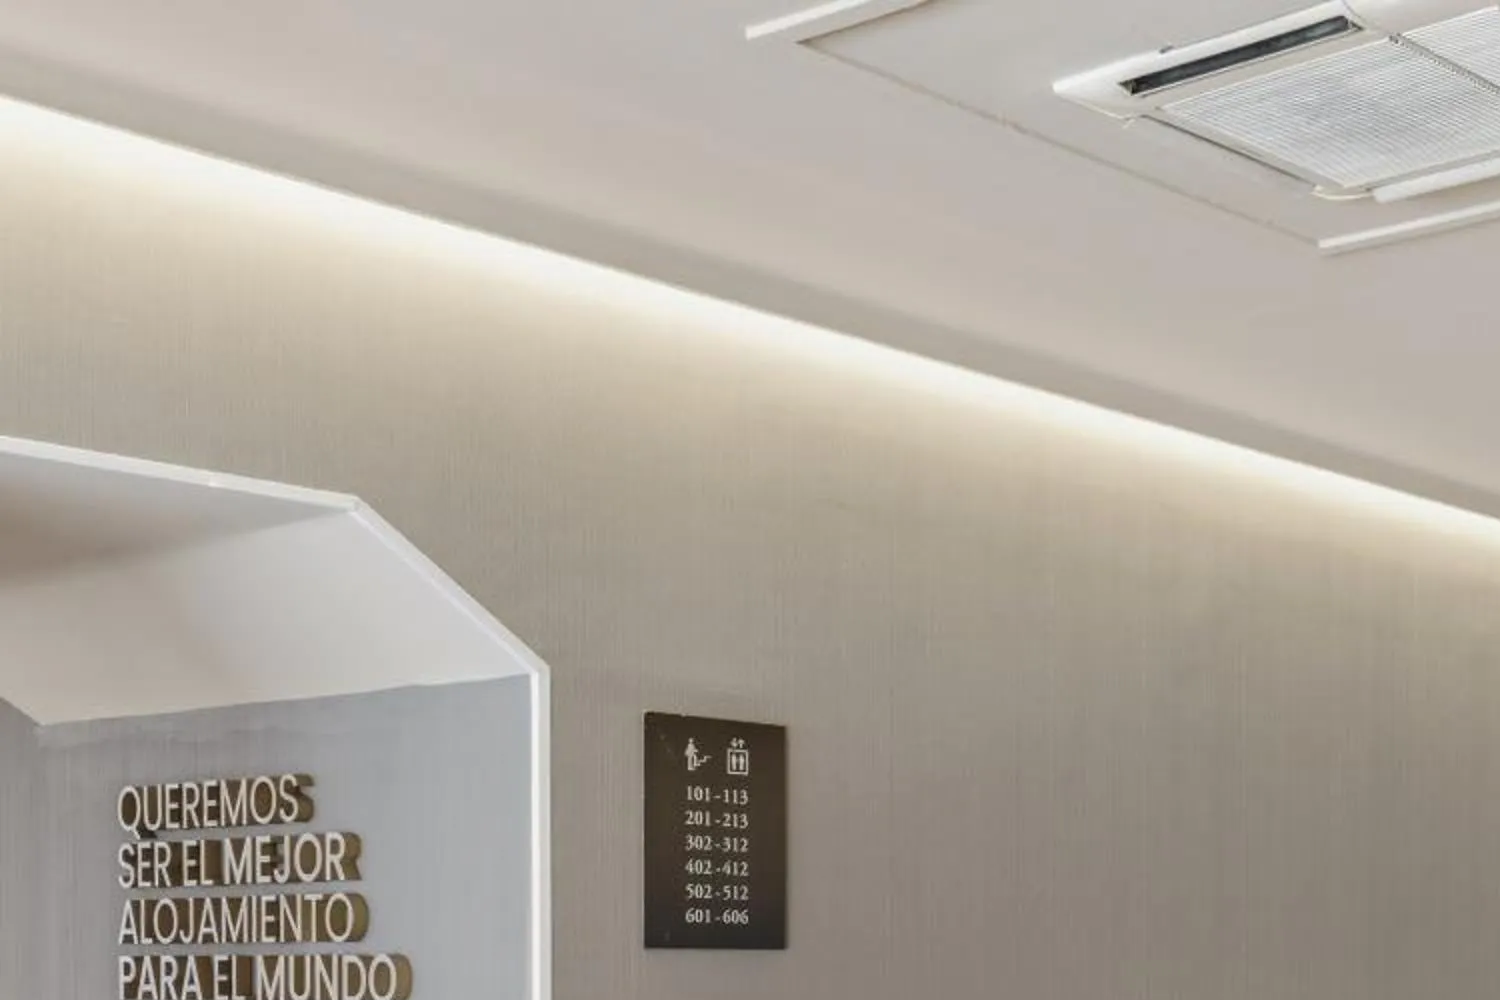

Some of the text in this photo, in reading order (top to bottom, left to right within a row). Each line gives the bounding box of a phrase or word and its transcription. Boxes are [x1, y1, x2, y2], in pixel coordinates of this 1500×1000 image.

[117, 773, 302, 840] QUEREMOS
[118, 831, 348, 888] SER EL MEJOR
[118, 892, 355, 945] ALOJAMIENTO
[118, 954, 203, 1000] PARA
